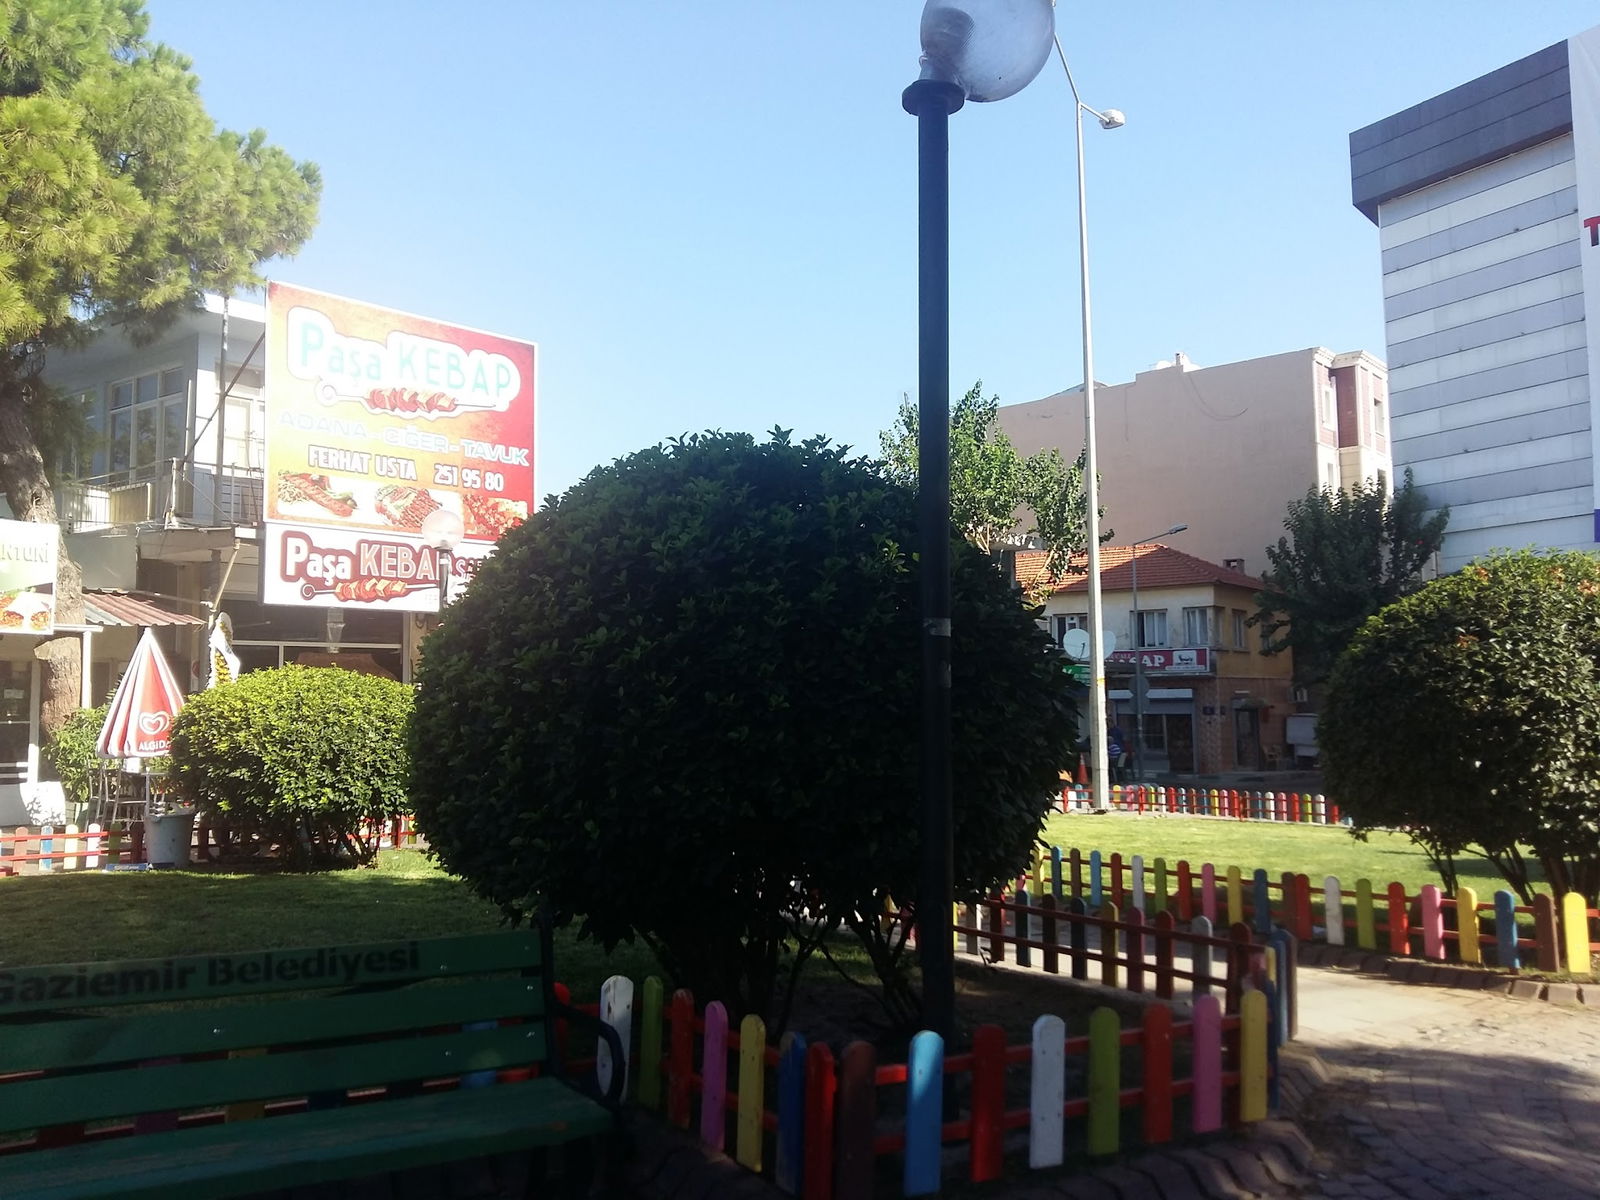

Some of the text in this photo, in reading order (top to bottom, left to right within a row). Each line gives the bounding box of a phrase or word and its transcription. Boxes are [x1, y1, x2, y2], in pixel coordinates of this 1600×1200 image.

[399, 340, 512, 397] KEBAP
[280, 411, 367, 438] ADANA
[462, 441, 530, 467] TAVUK
[308, 445, 504, 492] FERHAT USTA 251 95 80
[286, 537, 350, 586] Paşa
[0, 941, 420, 1002] Gaziemir Belediyesi
